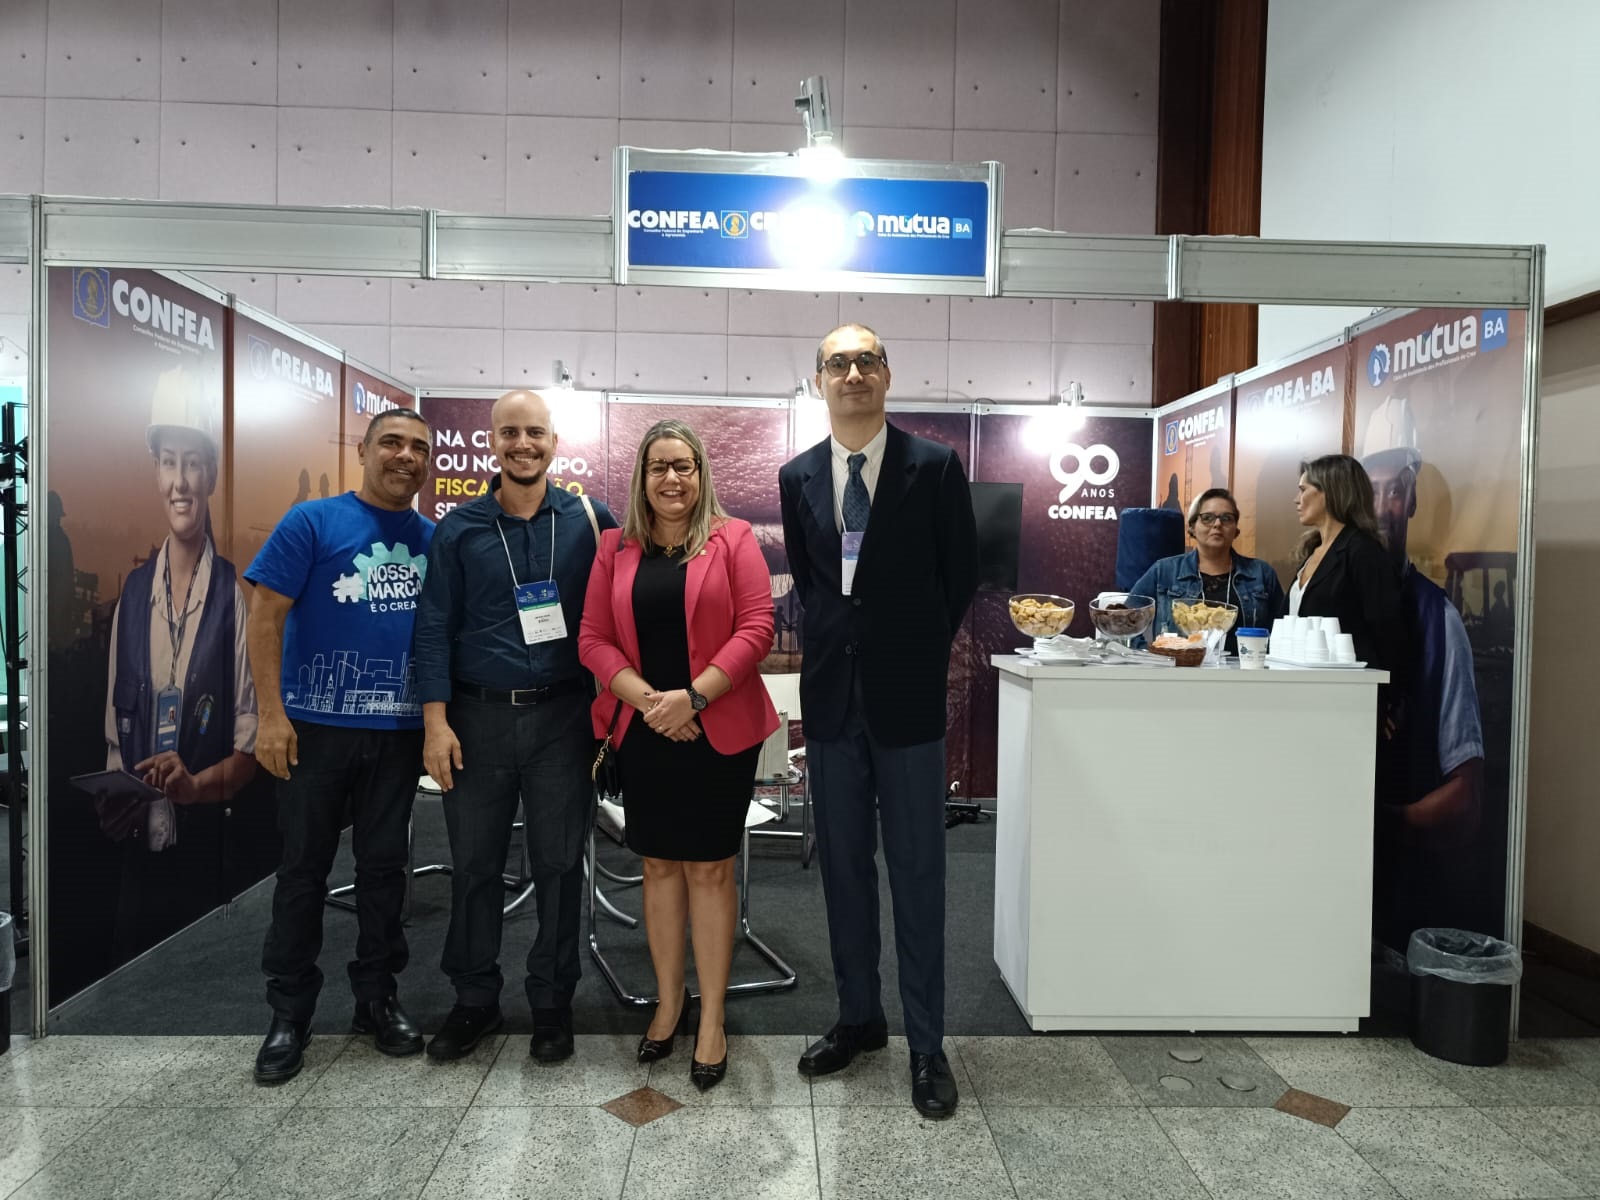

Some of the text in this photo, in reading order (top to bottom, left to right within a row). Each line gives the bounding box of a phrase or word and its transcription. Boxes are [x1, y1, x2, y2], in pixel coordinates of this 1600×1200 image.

[628, 210, 719, 229] CONFEA
[955, 223, 970, 233] BA
[112, 279, 215, 351] CONFEA
[1484, 317, 1504, 339] BA
[1178, 406, 1225, 441] CONFEA
[436, 429, 466, 448] NA
[435, 453, 467, 472] OU
[1049, 443, 1120, 504] 90
[1081, 488, 1115, 498] ANOS
[1048, 505, 1118, 521] CONFEA
[367, 562, 422, 584] NOSSA
[368, 579, 423, 601] MARCA
[379, 603, 388, 613] O
[389, 601, 417, 611] CREA
